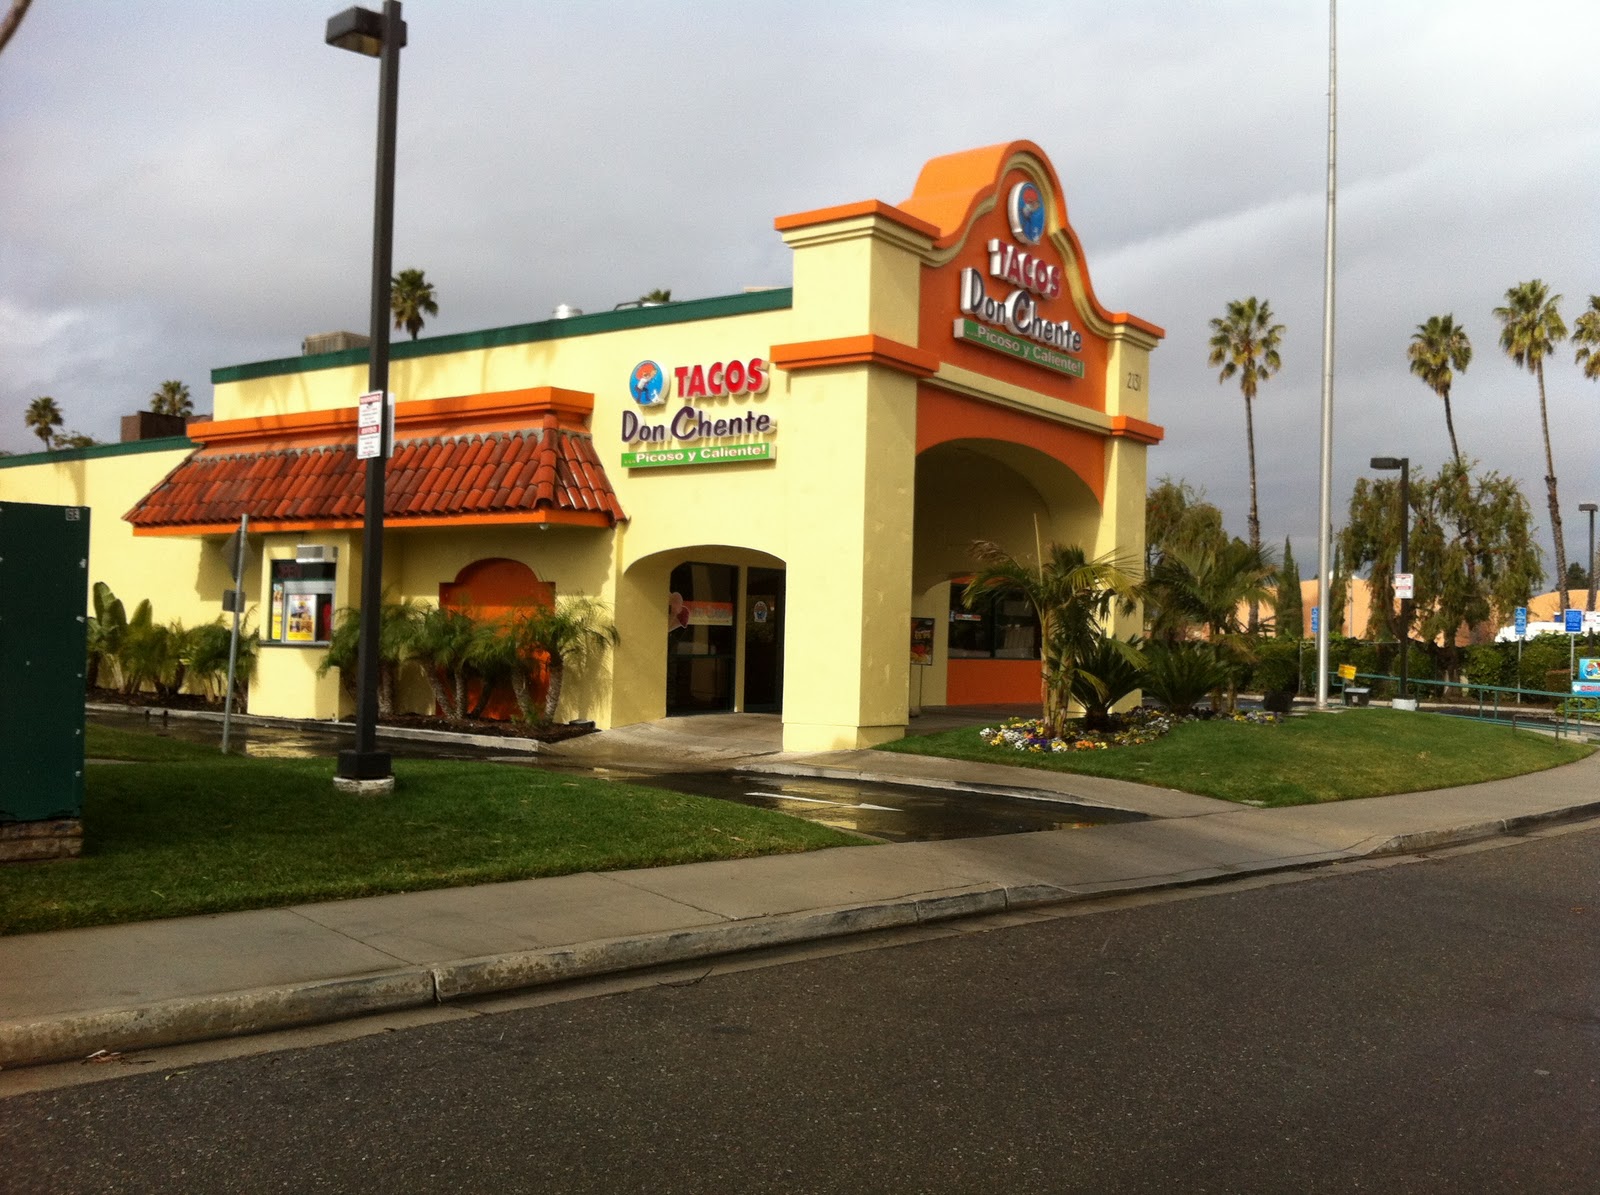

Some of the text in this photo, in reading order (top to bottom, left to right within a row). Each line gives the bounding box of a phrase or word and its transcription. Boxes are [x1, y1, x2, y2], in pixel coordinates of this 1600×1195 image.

[988, 238, 1061, 299] TACOS
[962, 267, 1083, 353] Don Chente
[674, 357, 768, 398] TACOS
[1023, 344, 1032, 358] y
[1032, 346, 1081, 373] Caliente!
[621, 405, 771, 442] Don Chente
[688, 450, 697, 462] y
[700, 444, 767, 459] Caliente!
